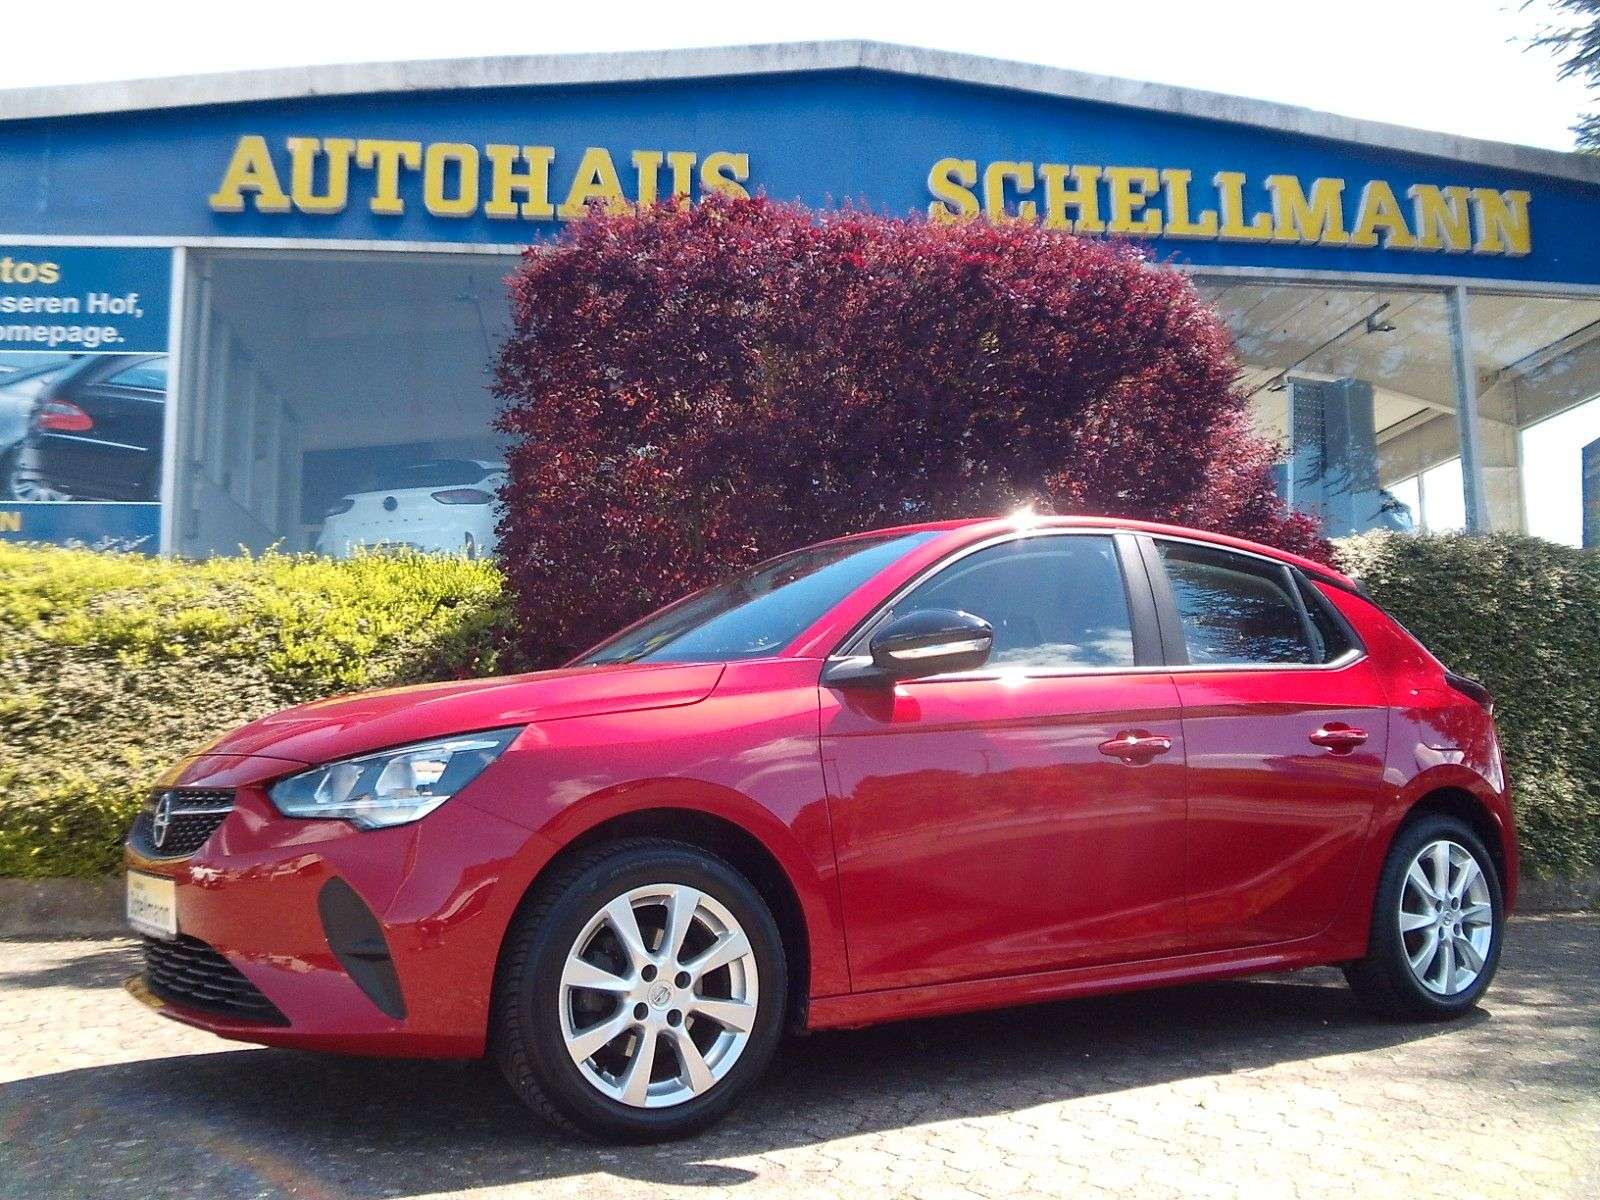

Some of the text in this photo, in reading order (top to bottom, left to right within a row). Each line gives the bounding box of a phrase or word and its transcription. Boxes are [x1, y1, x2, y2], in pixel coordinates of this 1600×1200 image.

[209, 134, 1532, 257] AUTOHAUS SCHELLMANN
[0, 257, 59, 284] tos
[87, 293, 143, 318] Hof,
[0, 325, 124, 347] mepage.
